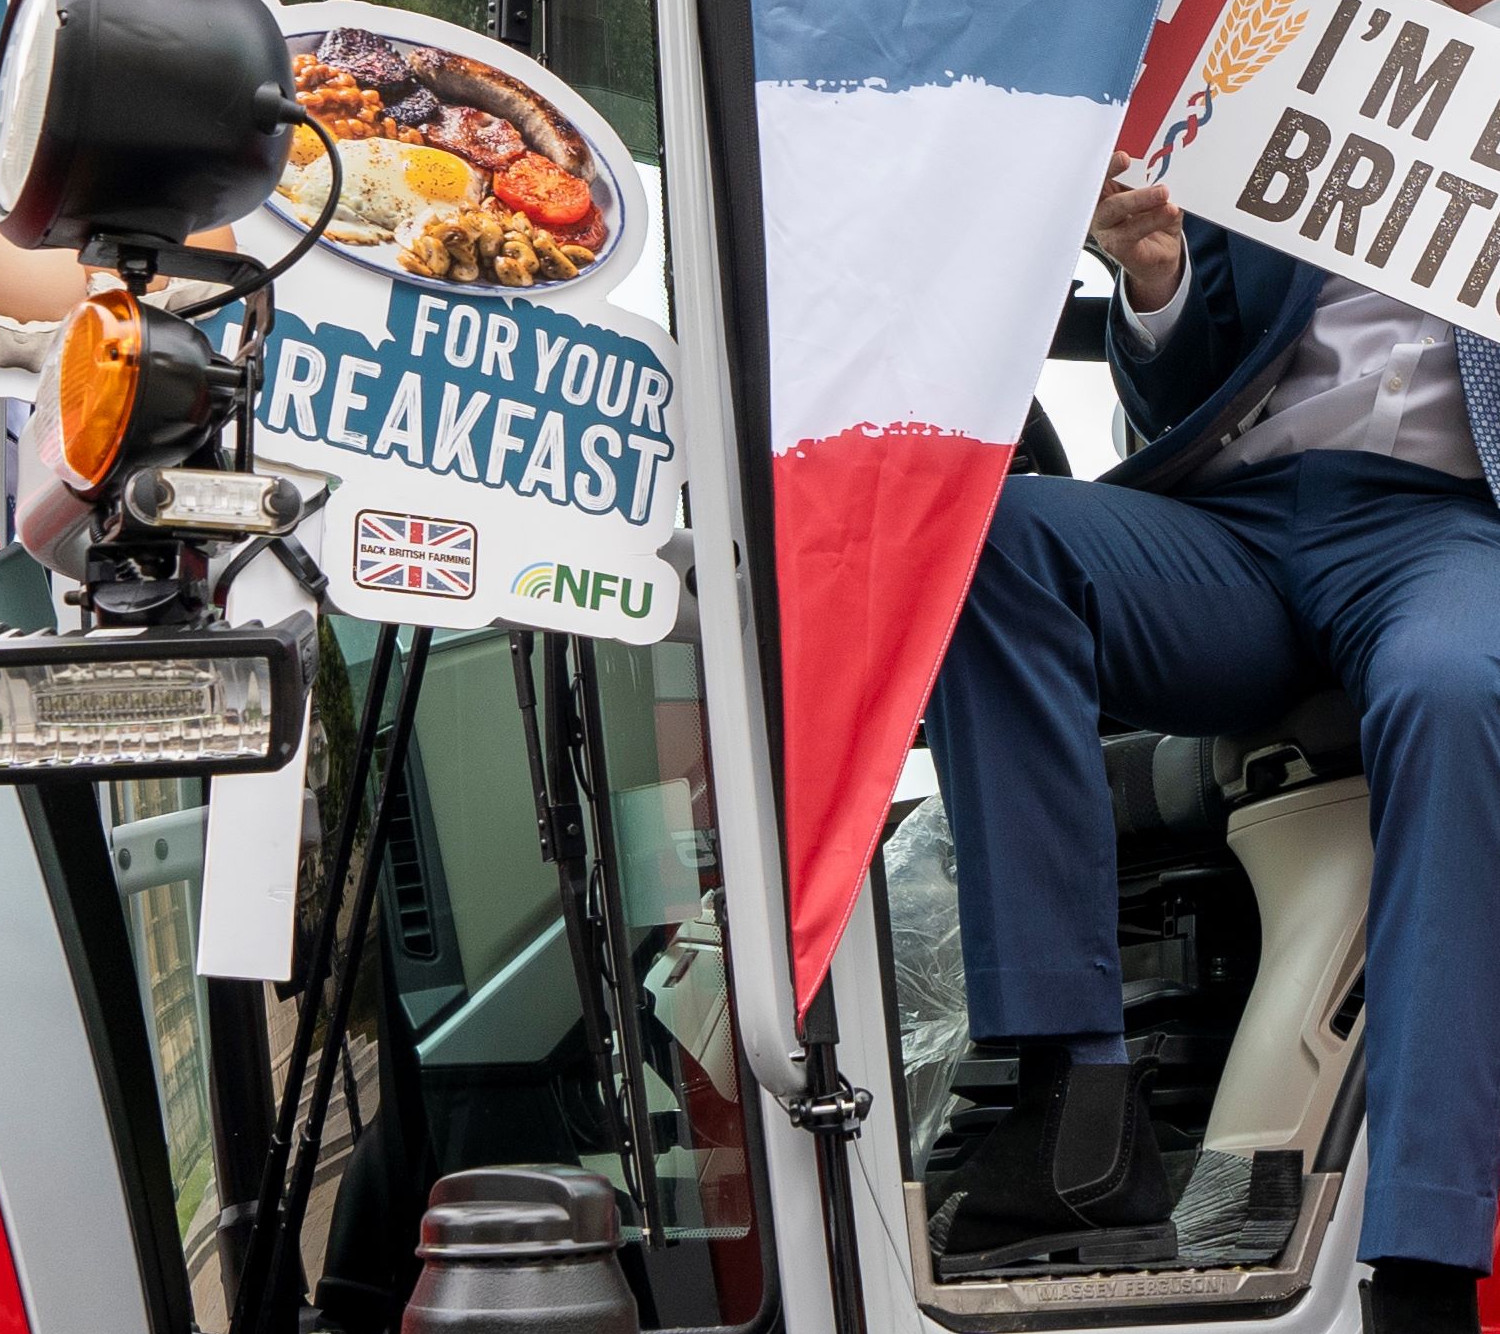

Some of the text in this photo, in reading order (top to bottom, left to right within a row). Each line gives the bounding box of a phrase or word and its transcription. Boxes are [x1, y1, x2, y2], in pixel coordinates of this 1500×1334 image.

[410, 294, 669, 434] FOR YOUR
[360, 544, 471, 566] BACK BRITISH FARMING
[553, 563, 654, 619] NFU
[1038, 1276, 1222, 1302] MASSEY FERGUSON
